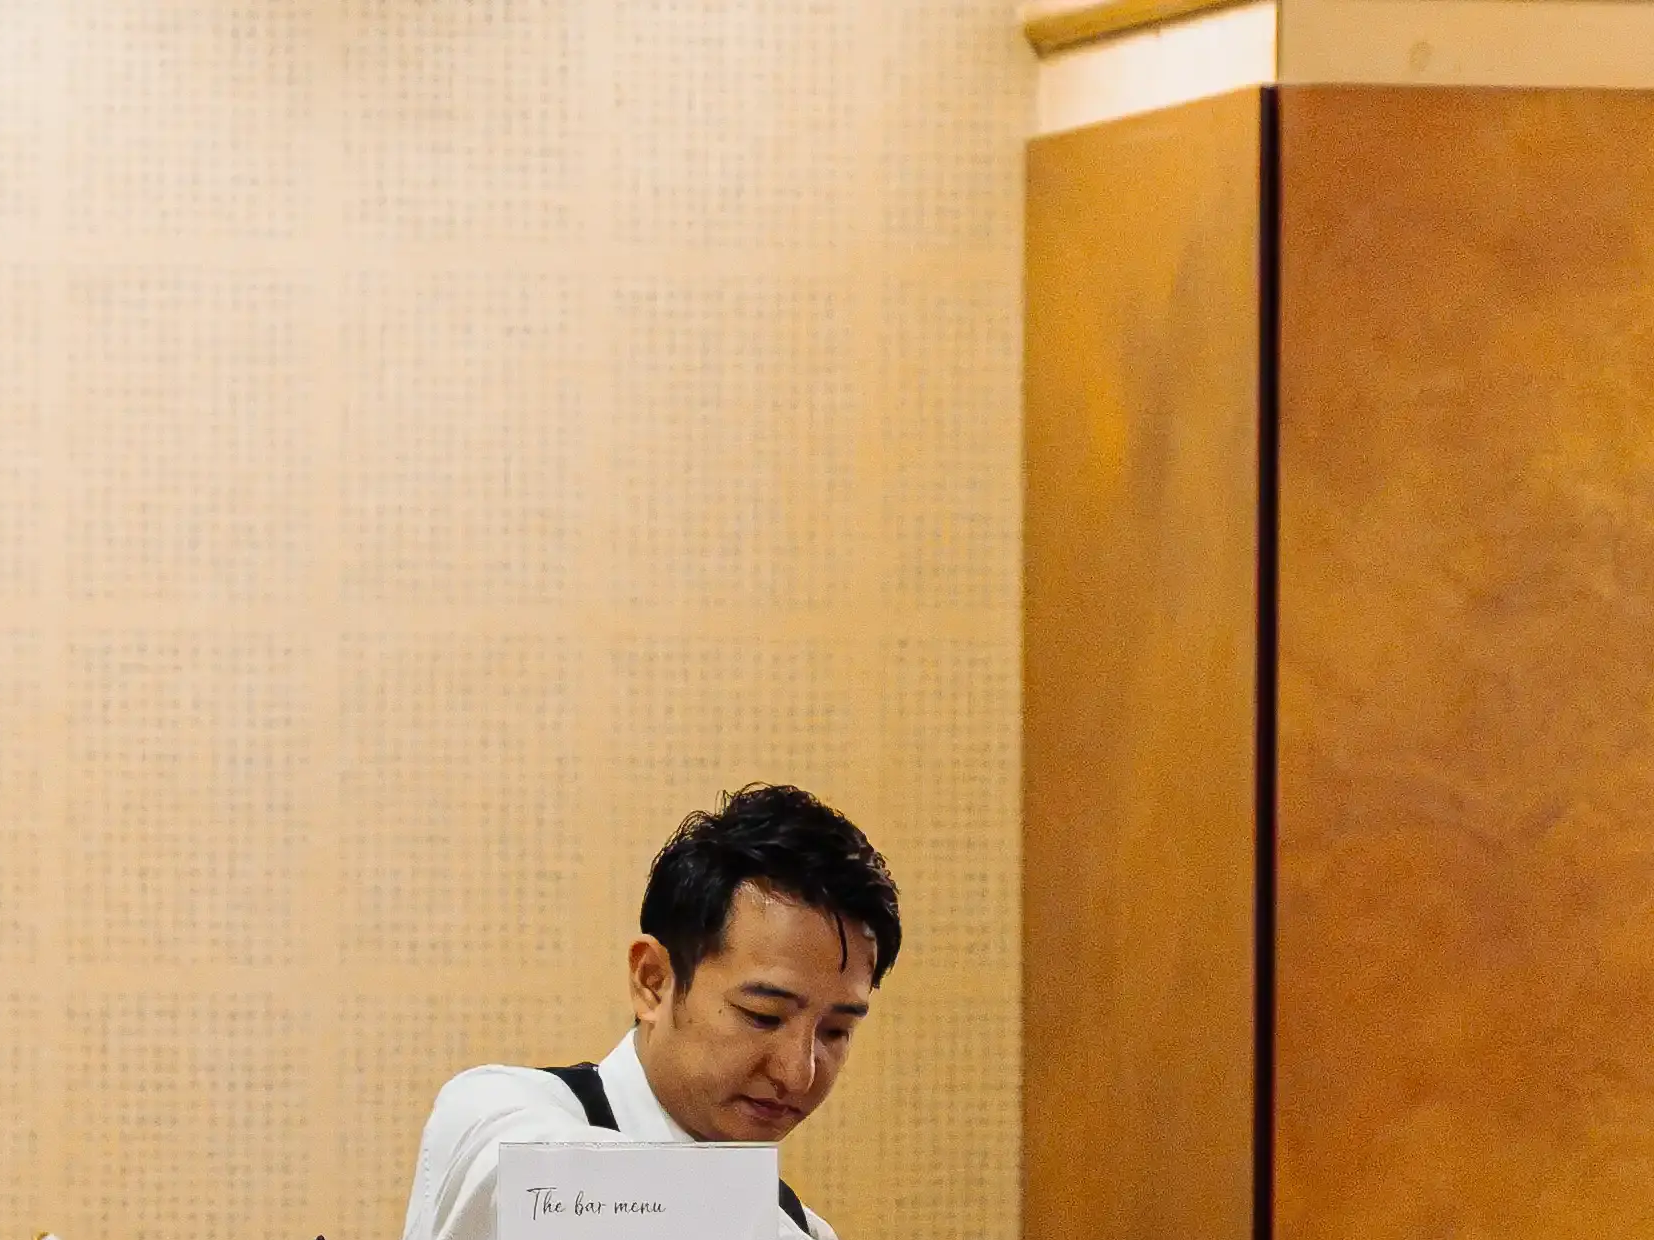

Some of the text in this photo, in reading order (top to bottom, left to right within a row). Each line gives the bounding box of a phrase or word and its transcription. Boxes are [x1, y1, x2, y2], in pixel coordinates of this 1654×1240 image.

[526, 1187, 666, 1220] The bar menu
